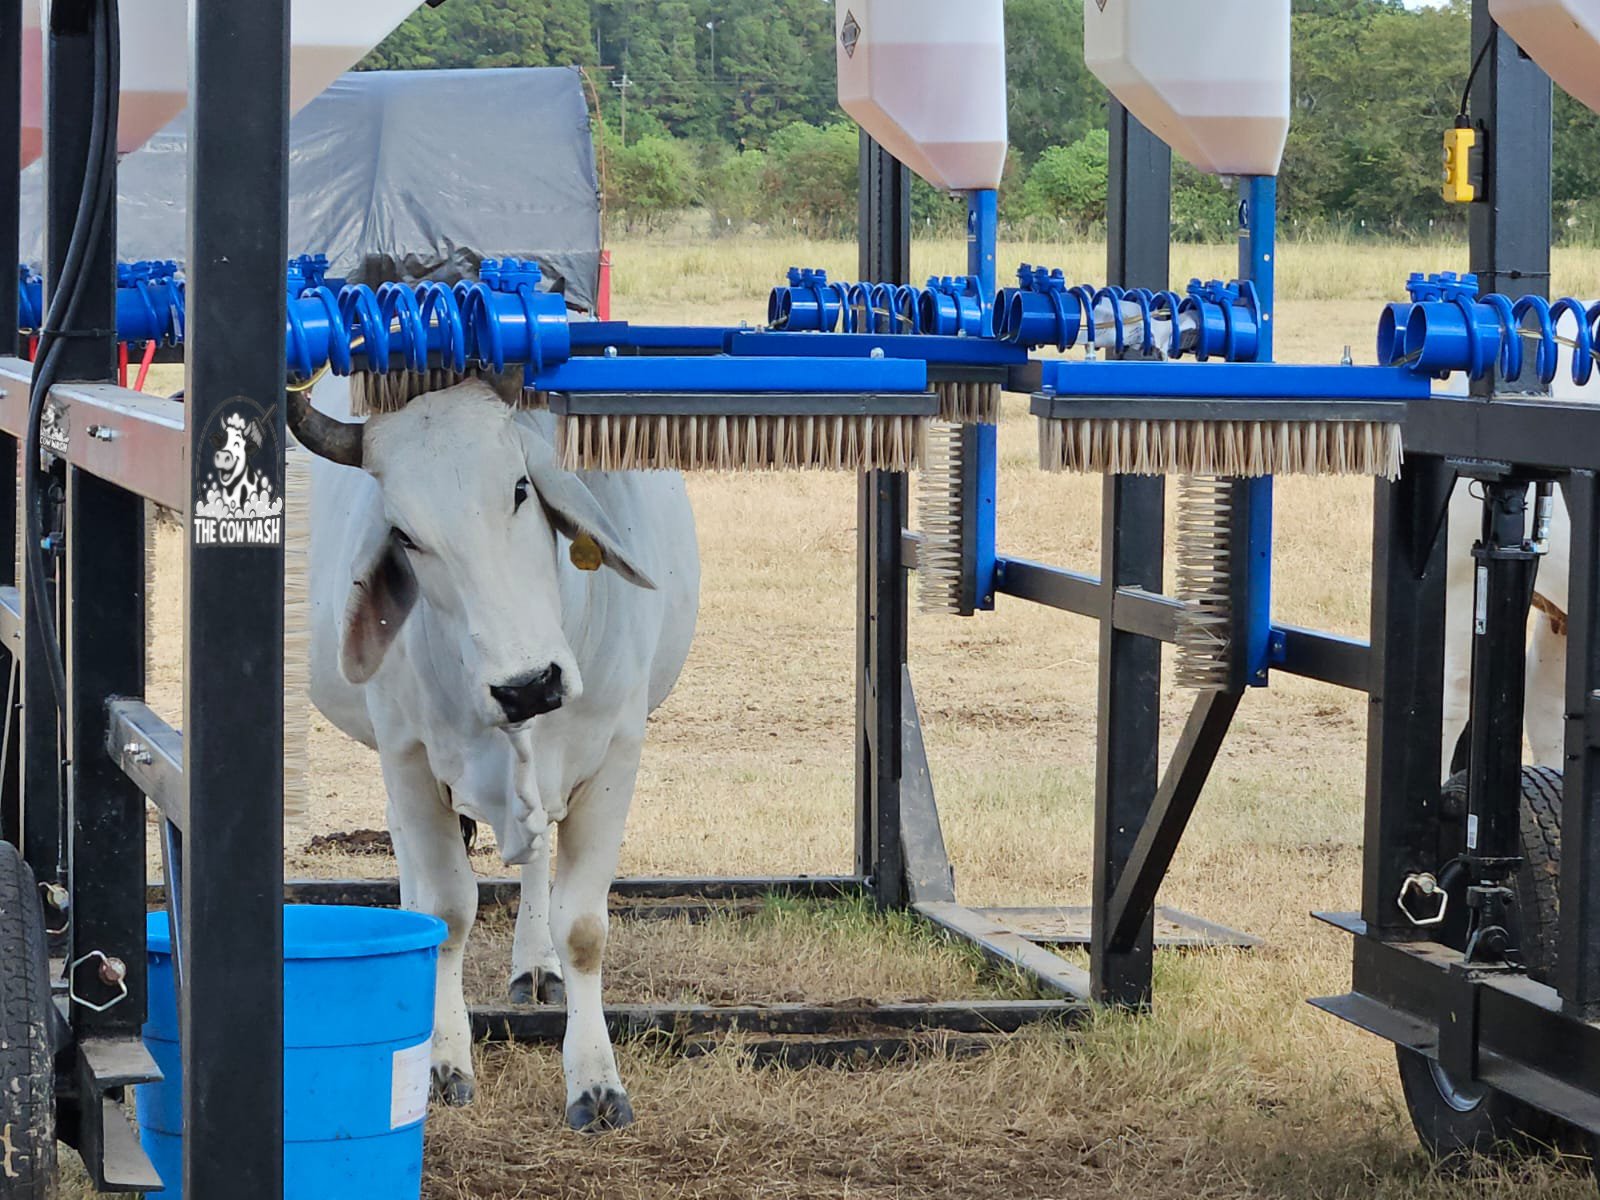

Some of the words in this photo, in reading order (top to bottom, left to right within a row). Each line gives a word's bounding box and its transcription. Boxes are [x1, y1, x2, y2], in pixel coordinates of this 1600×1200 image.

[194, 518, 217, 544] THE
[219, 520, 245, 543] COW
[246, 518, 280, 544] WASH
